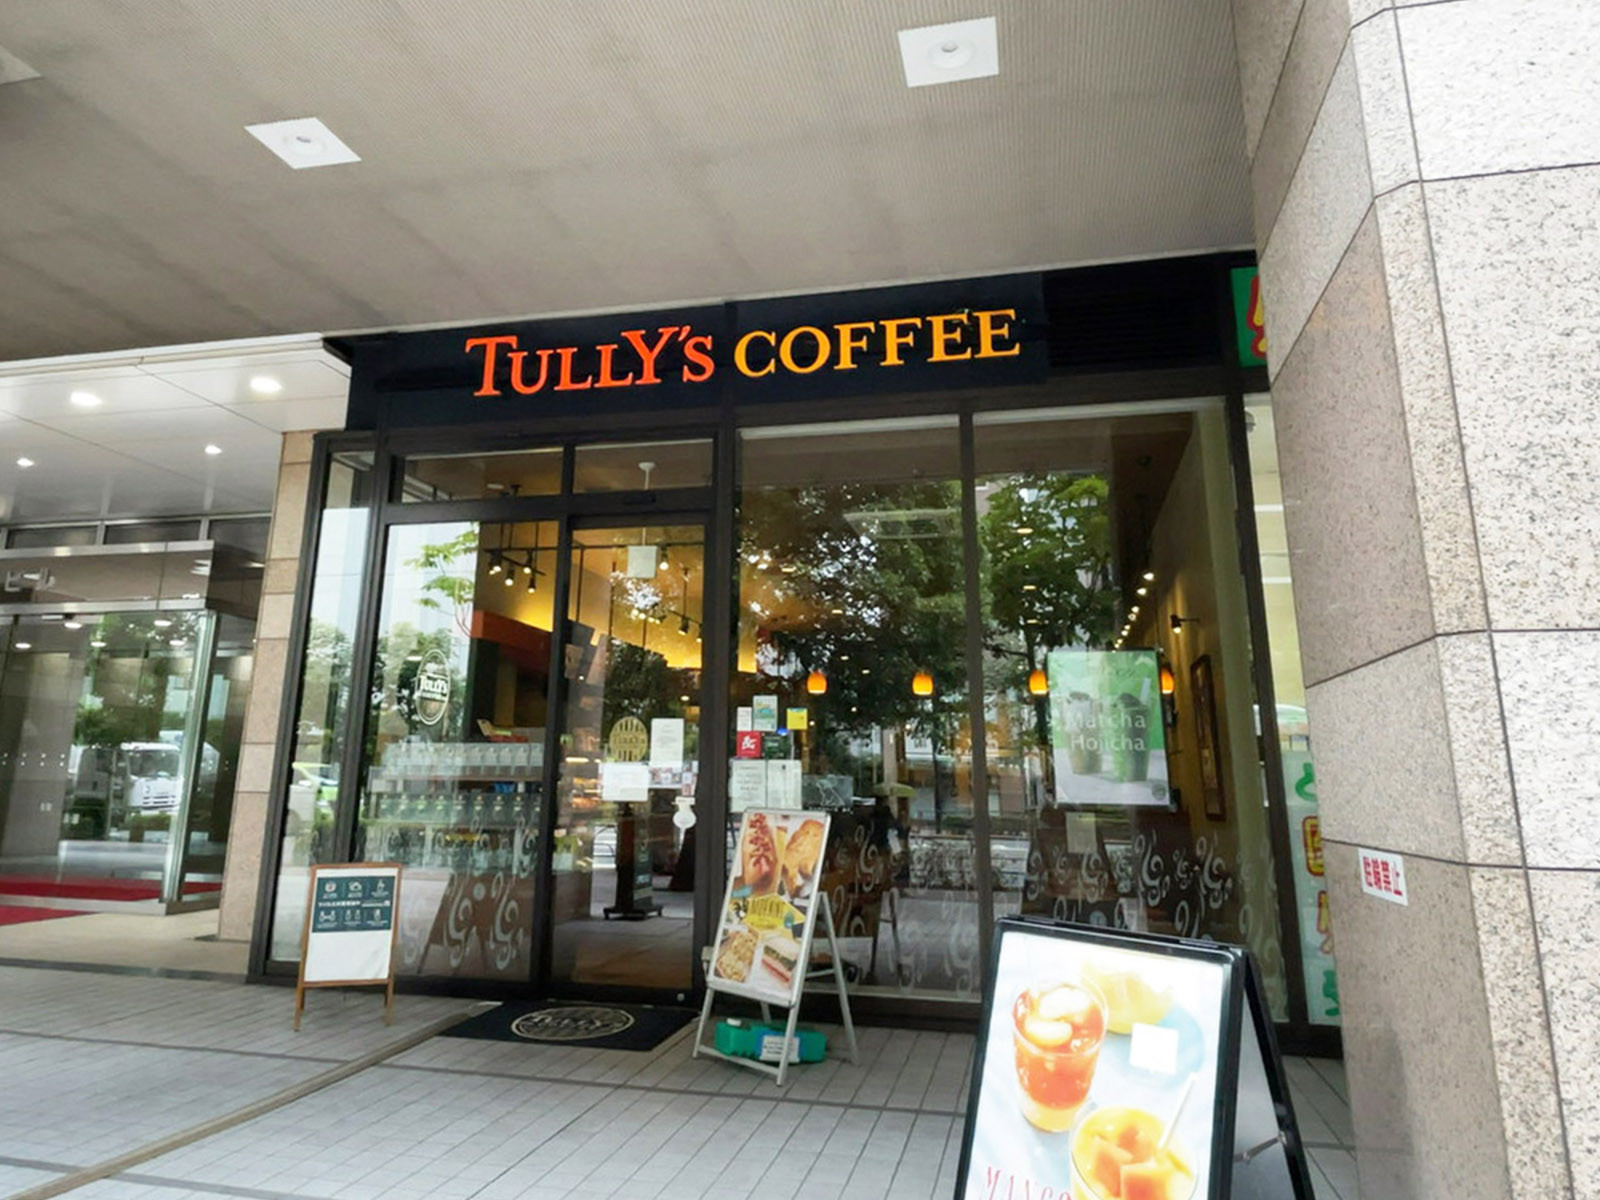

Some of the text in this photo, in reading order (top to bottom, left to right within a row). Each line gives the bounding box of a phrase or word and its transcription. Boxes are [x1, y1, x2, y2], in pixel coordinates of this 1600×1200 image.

[464, 308, 1021, 397] TULLY'S COFFEE
[1065, 711, 1147, 729] Matcha
